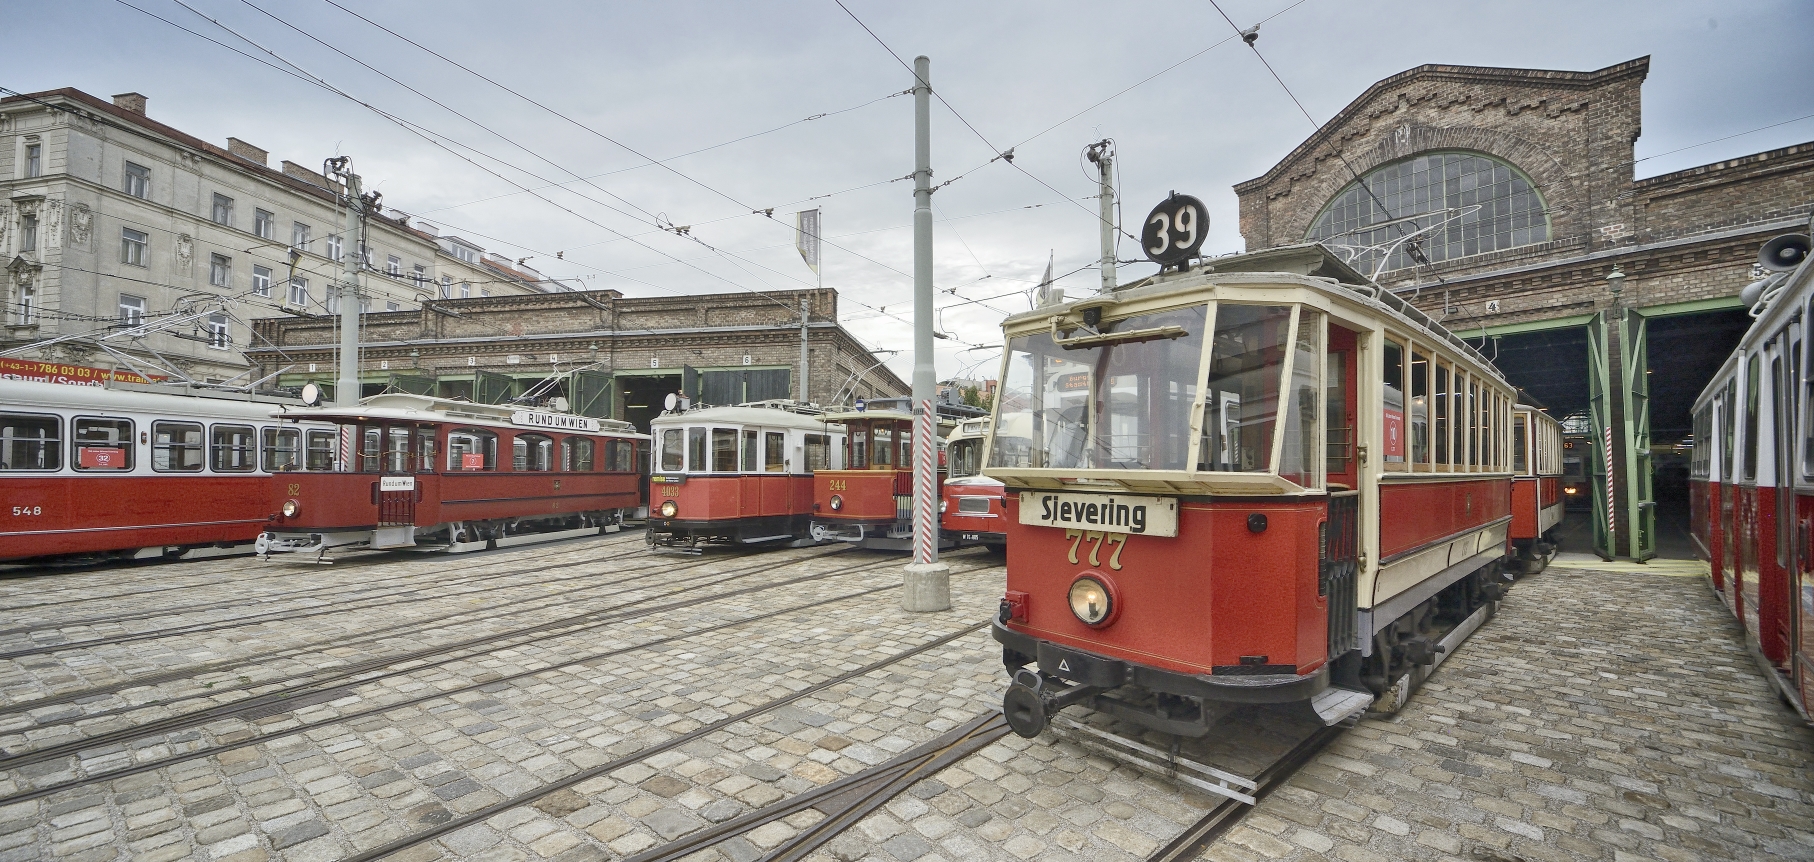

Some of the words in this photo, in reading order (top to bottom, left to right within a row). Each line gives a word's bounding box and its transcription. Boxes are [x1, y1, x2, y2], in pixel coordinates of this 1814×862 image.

[1149, 204, 1197, 256] 39
[1754, 265, 1764, 277] 5
[1488, 302, 1496, 311] 4
[469, 357, 474, 365] 3
[39, 363, 58, 374] 786
[61, 366, 74, 376] 03
[77, 368, 91, 378] 03
[529, 413, 553, 426] RUND
[556, 416, 567, 427] UM
[568, 418, 588, 429] WIEN
[288, 483, 300, 496] 82
[661, 485, 680, 497] 4033
[829, 479, 847, 491] 244
[12, 506, 42, 516] 548
[1041, 495, 1147, 533] Sievering
[1065, 527, 1129, 571] 777
